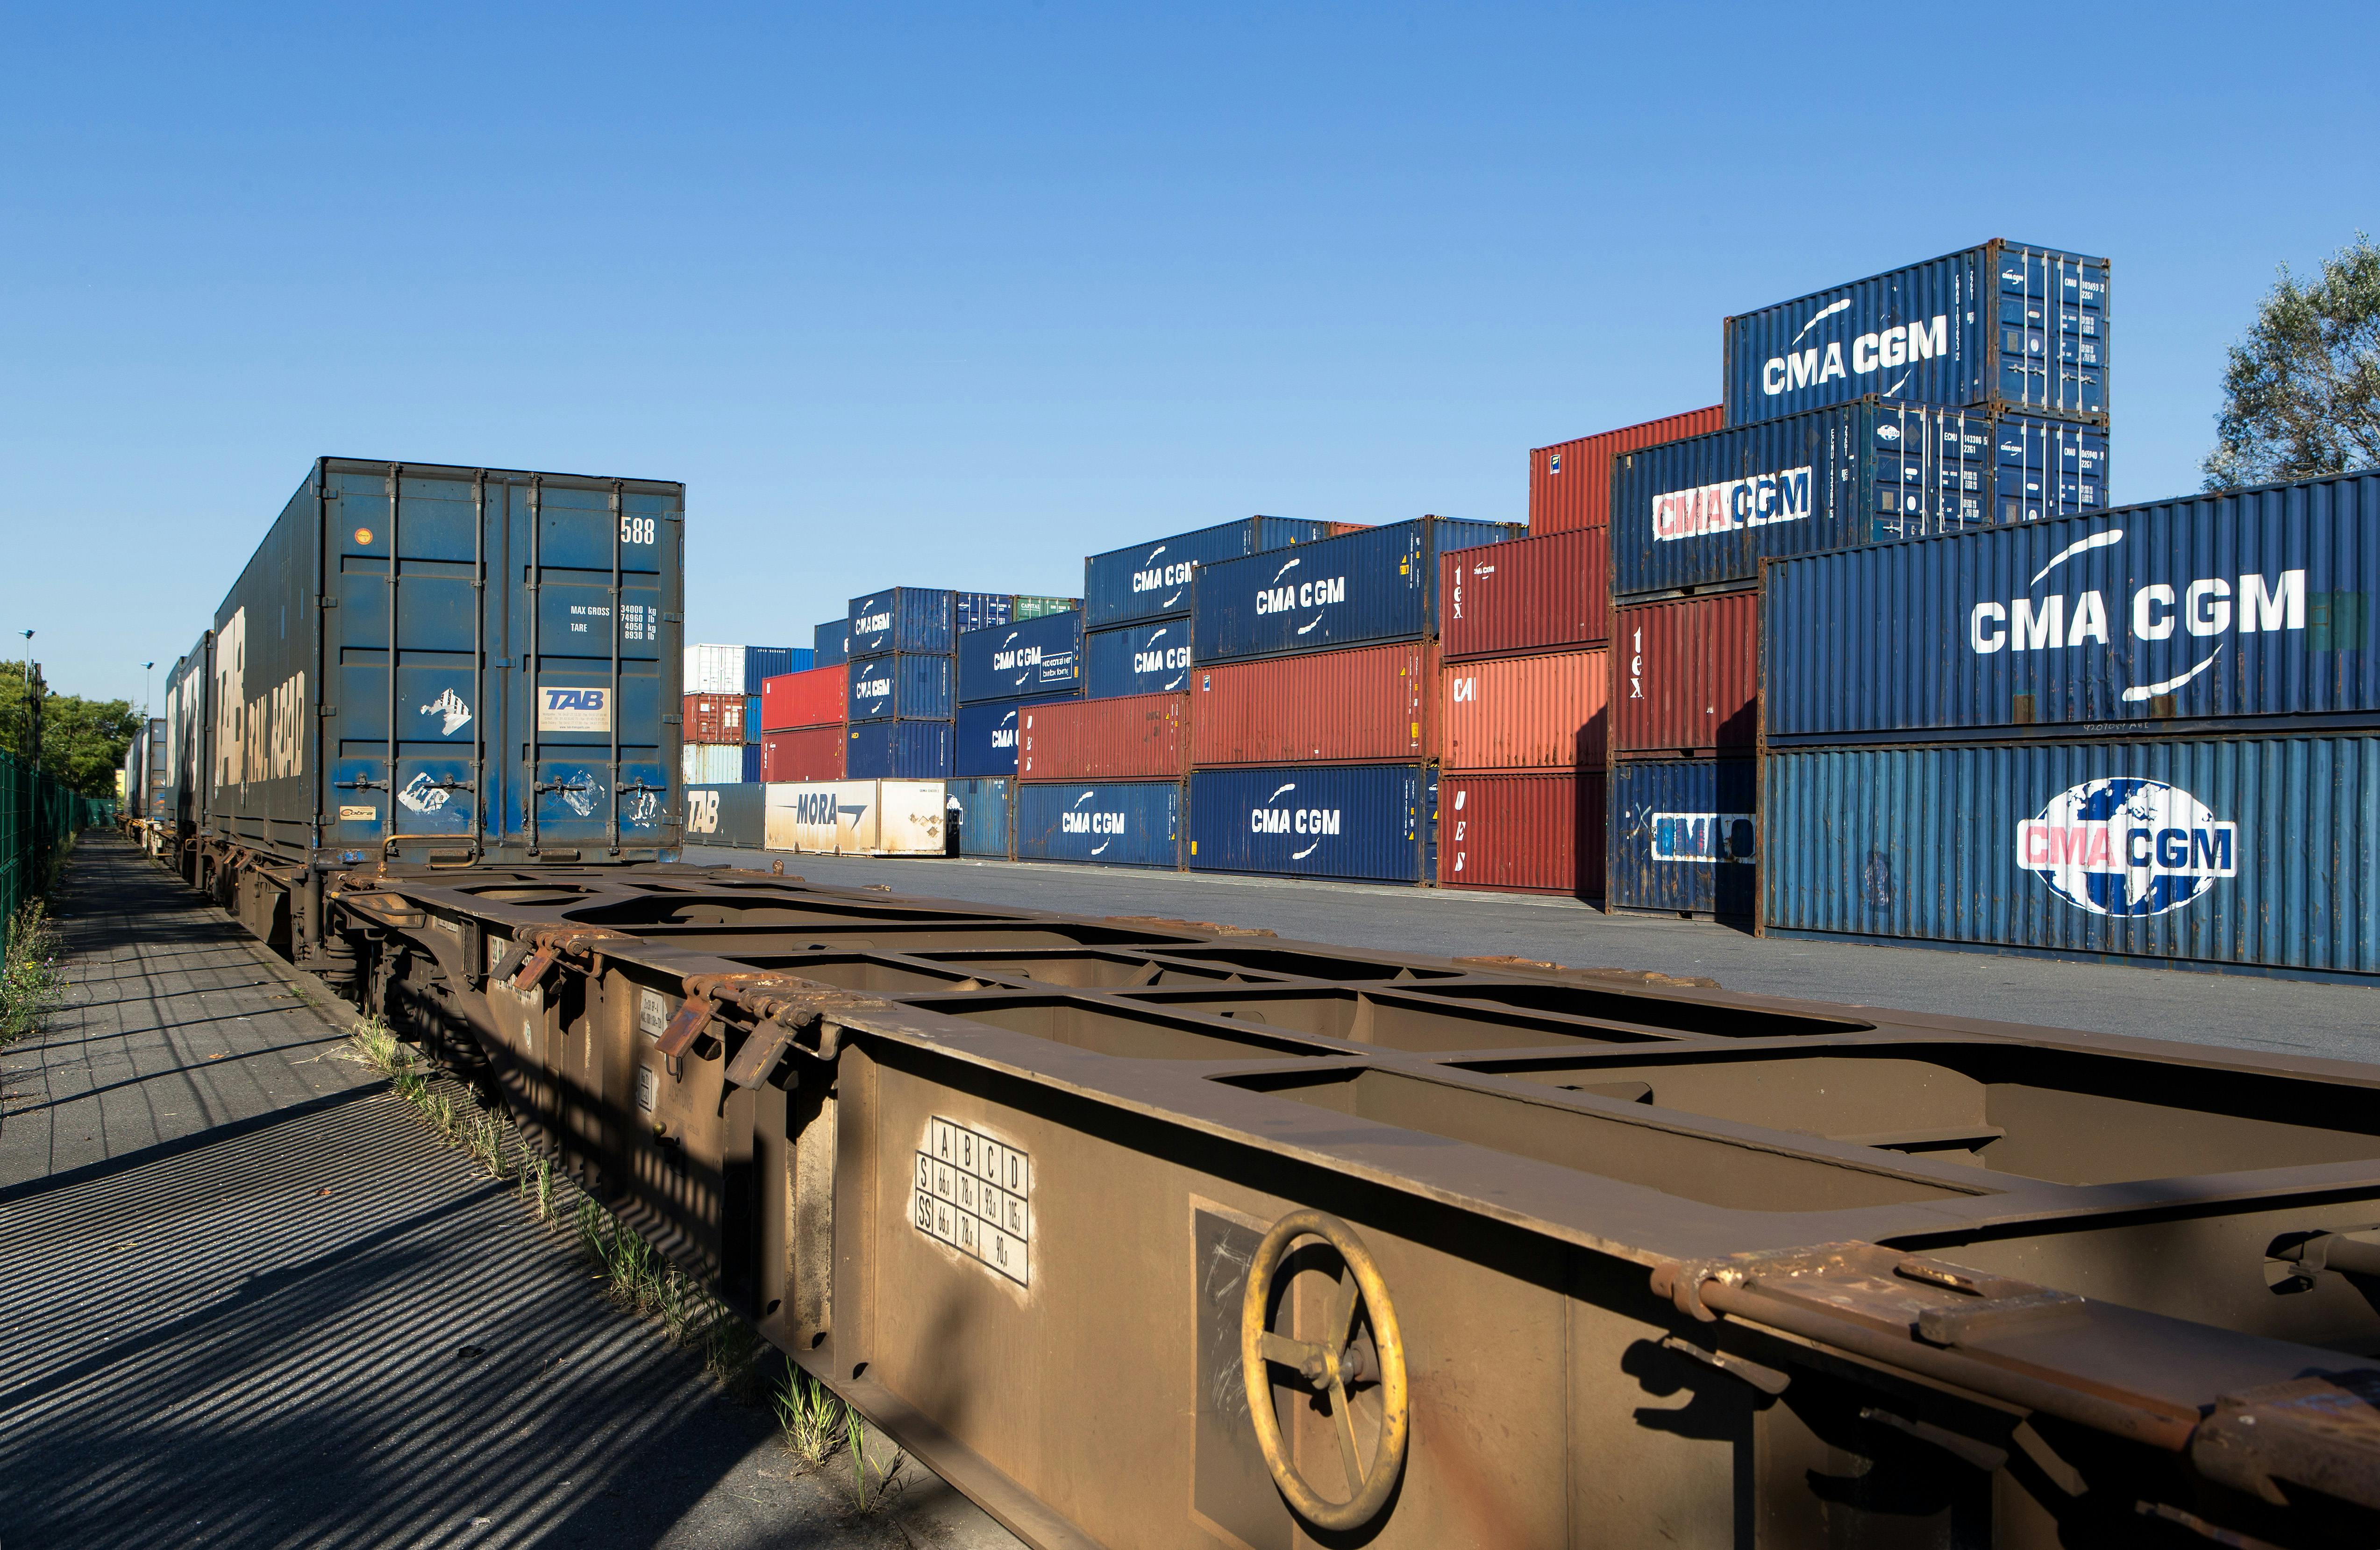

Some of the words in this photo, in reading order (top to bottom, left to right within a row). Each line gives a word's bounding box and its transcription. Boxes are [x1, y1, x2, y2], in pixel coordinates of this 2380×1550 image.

[2065, 278, 2077, 288] CMAU
[2082, 281, 2098, 292] 103653
[2082, 291, 2093, 300] 22G1
[1763, 342, 1846, 395] CMA
[1853, 315, 1946, 374] CGM
[1945, 432, 1957, 441] ECMU
[1964, 435, 1981, 444] 143306
[1983, 436, 1988, 445] 5
[1964, 445, 1976, 454] 22G1
[2081, 460, 2092, 469] 22G1
[1657, 490, 1726, 536] CMA
[1732, 472, 1808, 523] CGM
[621, 516, 655, 545] 588
[1133, 568, 1161, 592] CMA
[1257, 585, 1295, 615] CMA
[1300, 576, 1344, 607] CGM
[571, 606, 585, 615] MAX
[588, 607, 610, 616] GROSS
[621, 605, 643, 614] 34000
[648, 606, 656, 616] kg
[621, 614, 643, 622] 74960
[1971, 590, 2108, 654] CMA
[2133, 569, 2305, 640] CGM
[571, 623, 587, 632] TARE
[625, 623, 642, 631] 4050
[648, 624, 656, 633] kg
[855, 617, 871, 635] CMA
[871, 612, 890, 631] CGM
[625, 631, 643, 640] 8930
[994, 651, 1014, 670] CMA
[1017, 646, 1041, 667] CGM
[1134, 650, 1163, 673] CMA
[215, 606, 245, 787] TAB
[271, 670, 305, 779] ROAD
[546, 690, 604, 710] TAB
[856, 682, 871, 699] CMA
[872, 678, 890, 696] CGM
[992, 729, 1013, 748] CMA
[688, 790, 720, 833] TAB
[797, 793, 837, 825] MORA
[1062, 812, 1090, 833] CMA
[1093, 813, 1124, 834] CGM
[1252, 810, 1290, 833] CMA
[1295, 810, 1340, 835] CGM
[2025, 826, 2116, 867] CMA
[2127, 828, 2231, 869] CGM
[941, 1127, 948, 1159] A
[965, 1135, 971, 1166] B
[988, 1145, 994, 1178] C
[1012, 1155, 1018, 1189] D
[921, 1157, 926, 1187] S
[939, 1167, 950, 1197] 66,0
[962, 1177, 972, 1206] 78,0
[985, 1187, 996, 1218] 93,0
[1009, 1200, 1020, 1233] 105,0
[919, 1195, 931, 1228] SS
[938, 1206, 949, 1236] 66,0
[962, 1216, 972, 1246] 78,0
[997, 1235, 1007, 1268] 90,0
